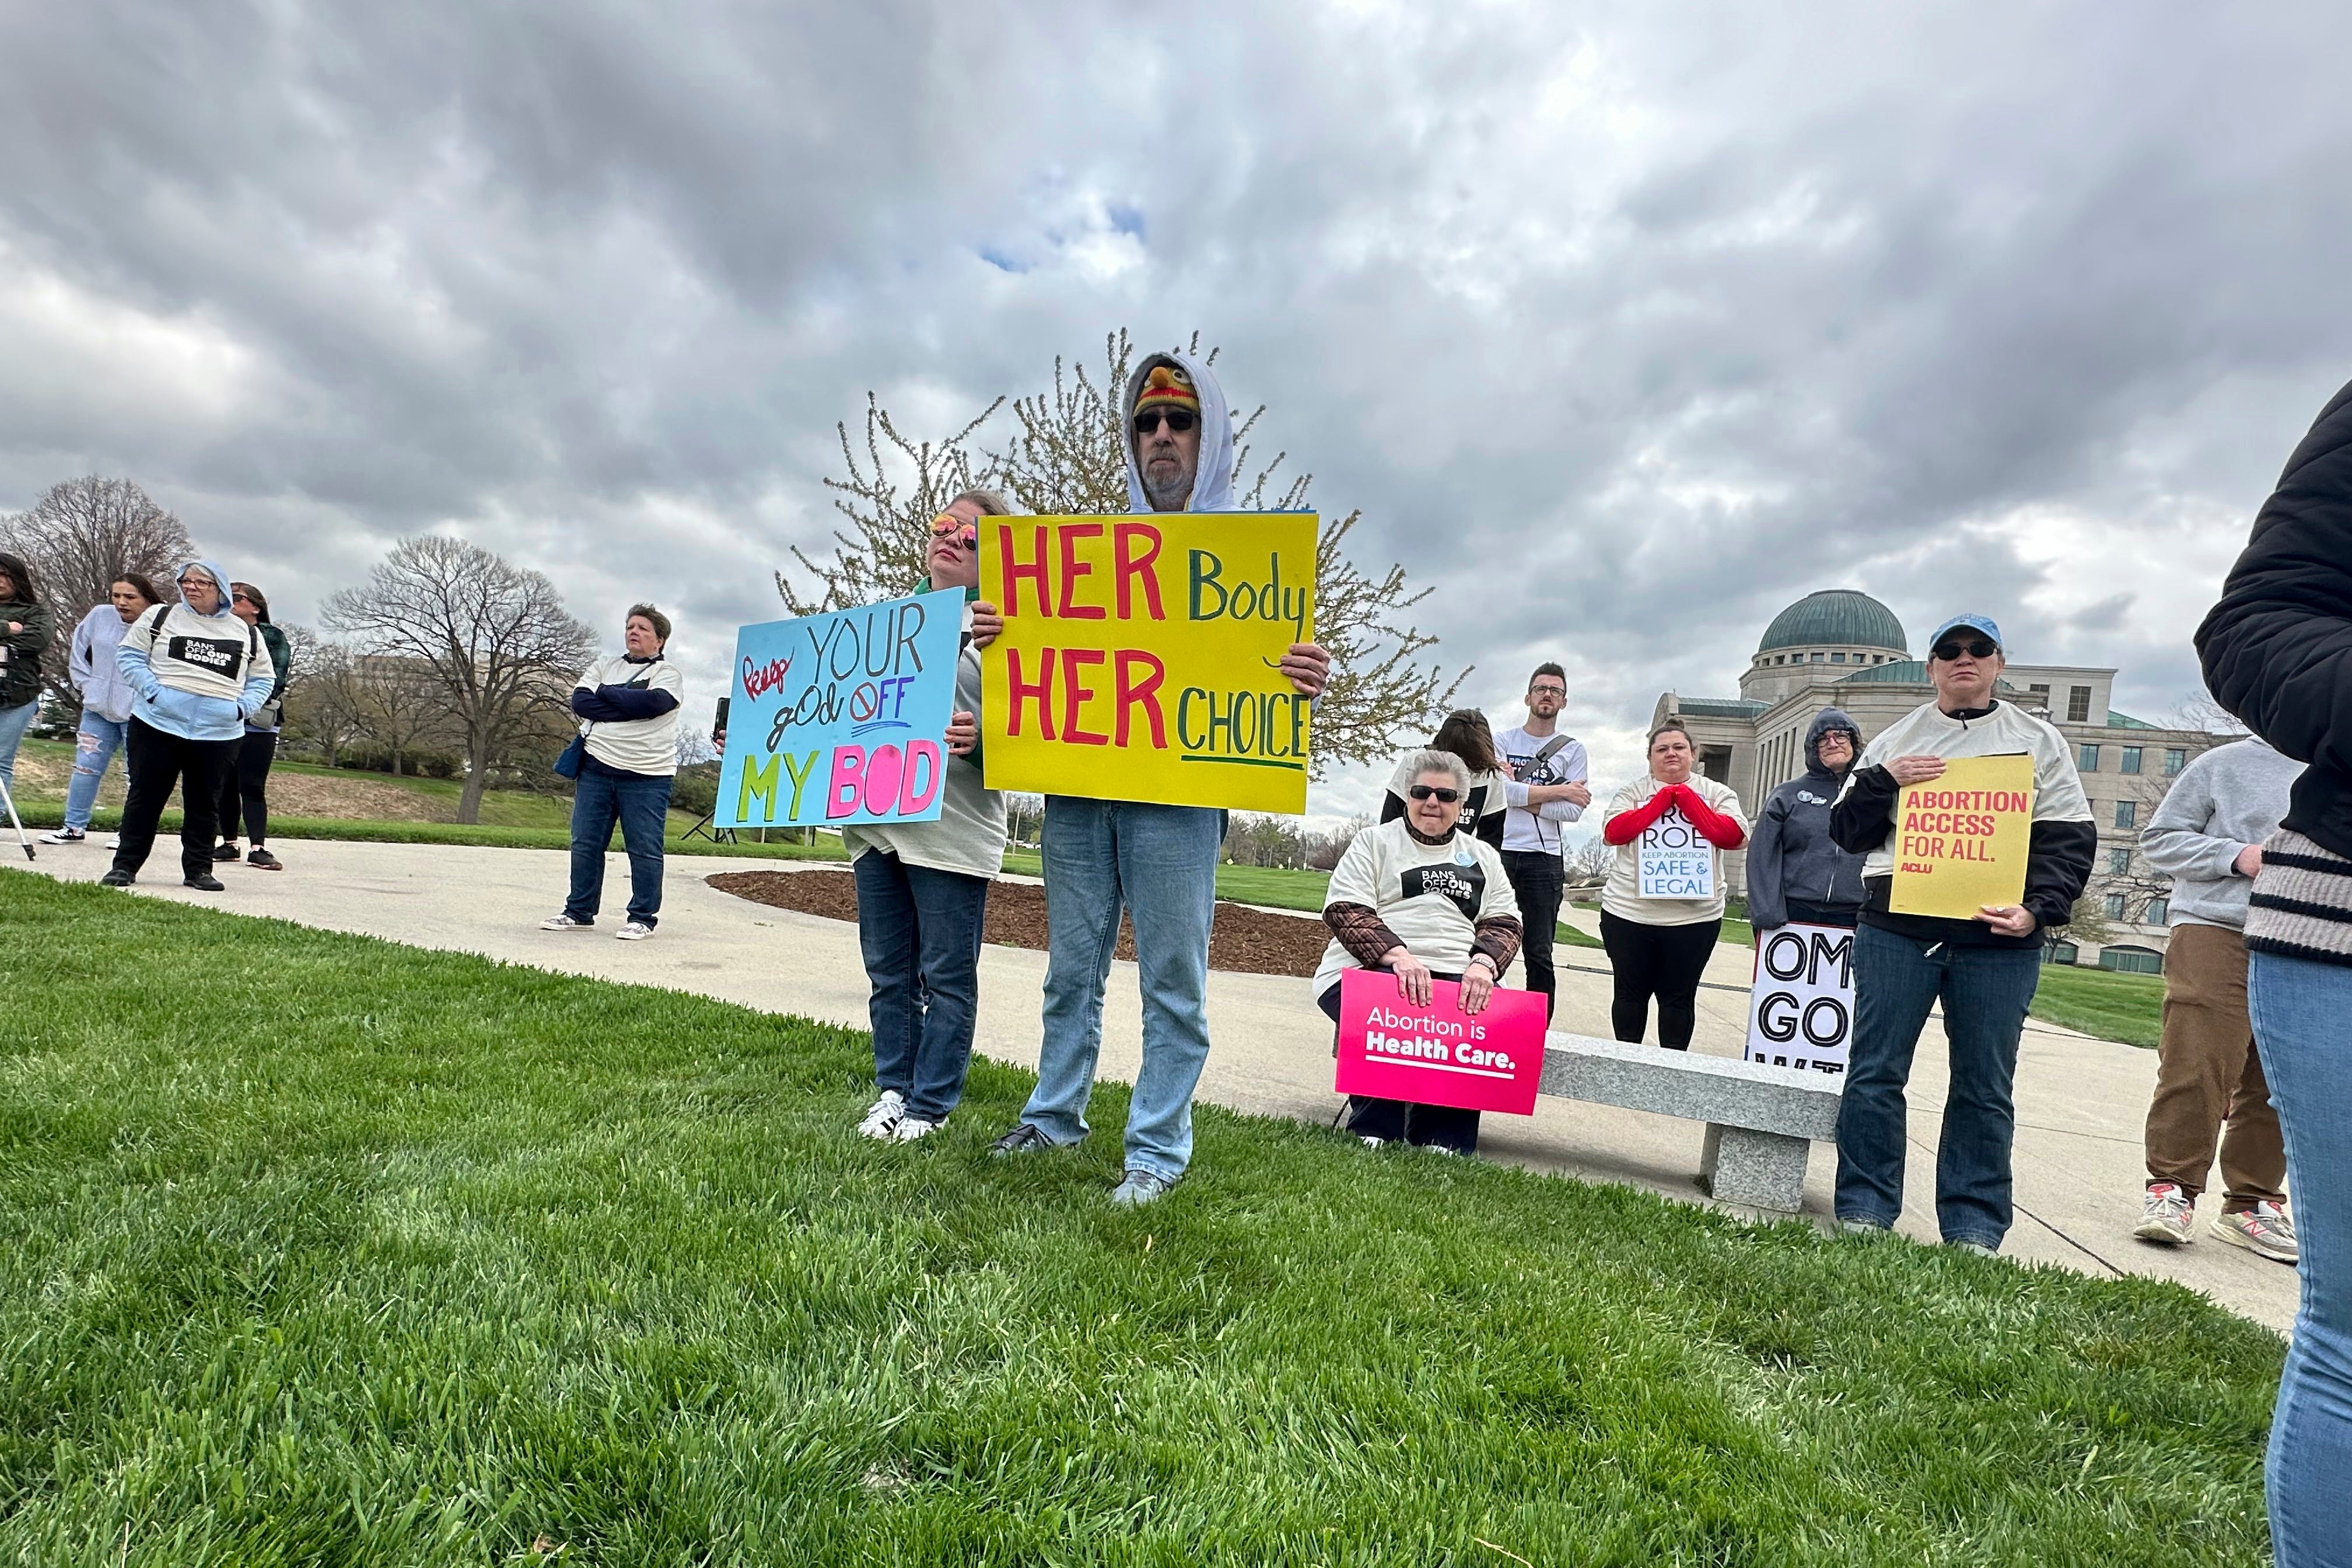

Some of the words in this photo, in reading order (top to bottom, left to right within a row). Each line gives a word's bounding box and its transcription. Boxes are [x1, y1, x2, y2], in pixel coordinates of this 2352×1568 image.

[999, 523, 1166, 620] HER
[1189, 549, 1306, 643] Body
[185, 646, 205, 655] OFF
[206, 650, 232, 662] OUR
[187, 639, 215, 651] BANS
[807, 603, 925, 684] YOUR
[184, 652, 226, 666] BODIES
[849, 676, 915, 722] OFF
[1006, 648, 1168, 748] HER
[1177, 687, 1307, 758] CHOICE
[736, 751, 820, 822] MY
[825, 740, 941, 820] BOD
[1461, 808, 1475, 817] UR
[1906, 791, 2027, 813] ABORTION
[1904, 813, 1995, 836] ACCESS
[1643, 827, 1707, 849] ROE
[1903, 836, 1944, 858] FOR
[1950, 839, 1996, 862] ALL.
[1422, 870, 1456, 880] BANS
[1644, 860, 1690, 876] SAFE
[1696, 862, 1707, 874] &
[1901, 862, 1933, 874] ACLU
[1422, 879, 1447, 888] OFF
[1448, 879, 1472, 893] OUR
[1645, 879, 1709, 894] LEGAL
[1765, 932, 1854, 989] OM
[1366, 1006, 1462, 1037] Abortion
[1470, 1020, 1486, 1040] is
[1758, 992, 1849, 1048] GO
[1366, 1030, 1448, 1060] Health
[1455, 1042, 1516, 1070] Care.
